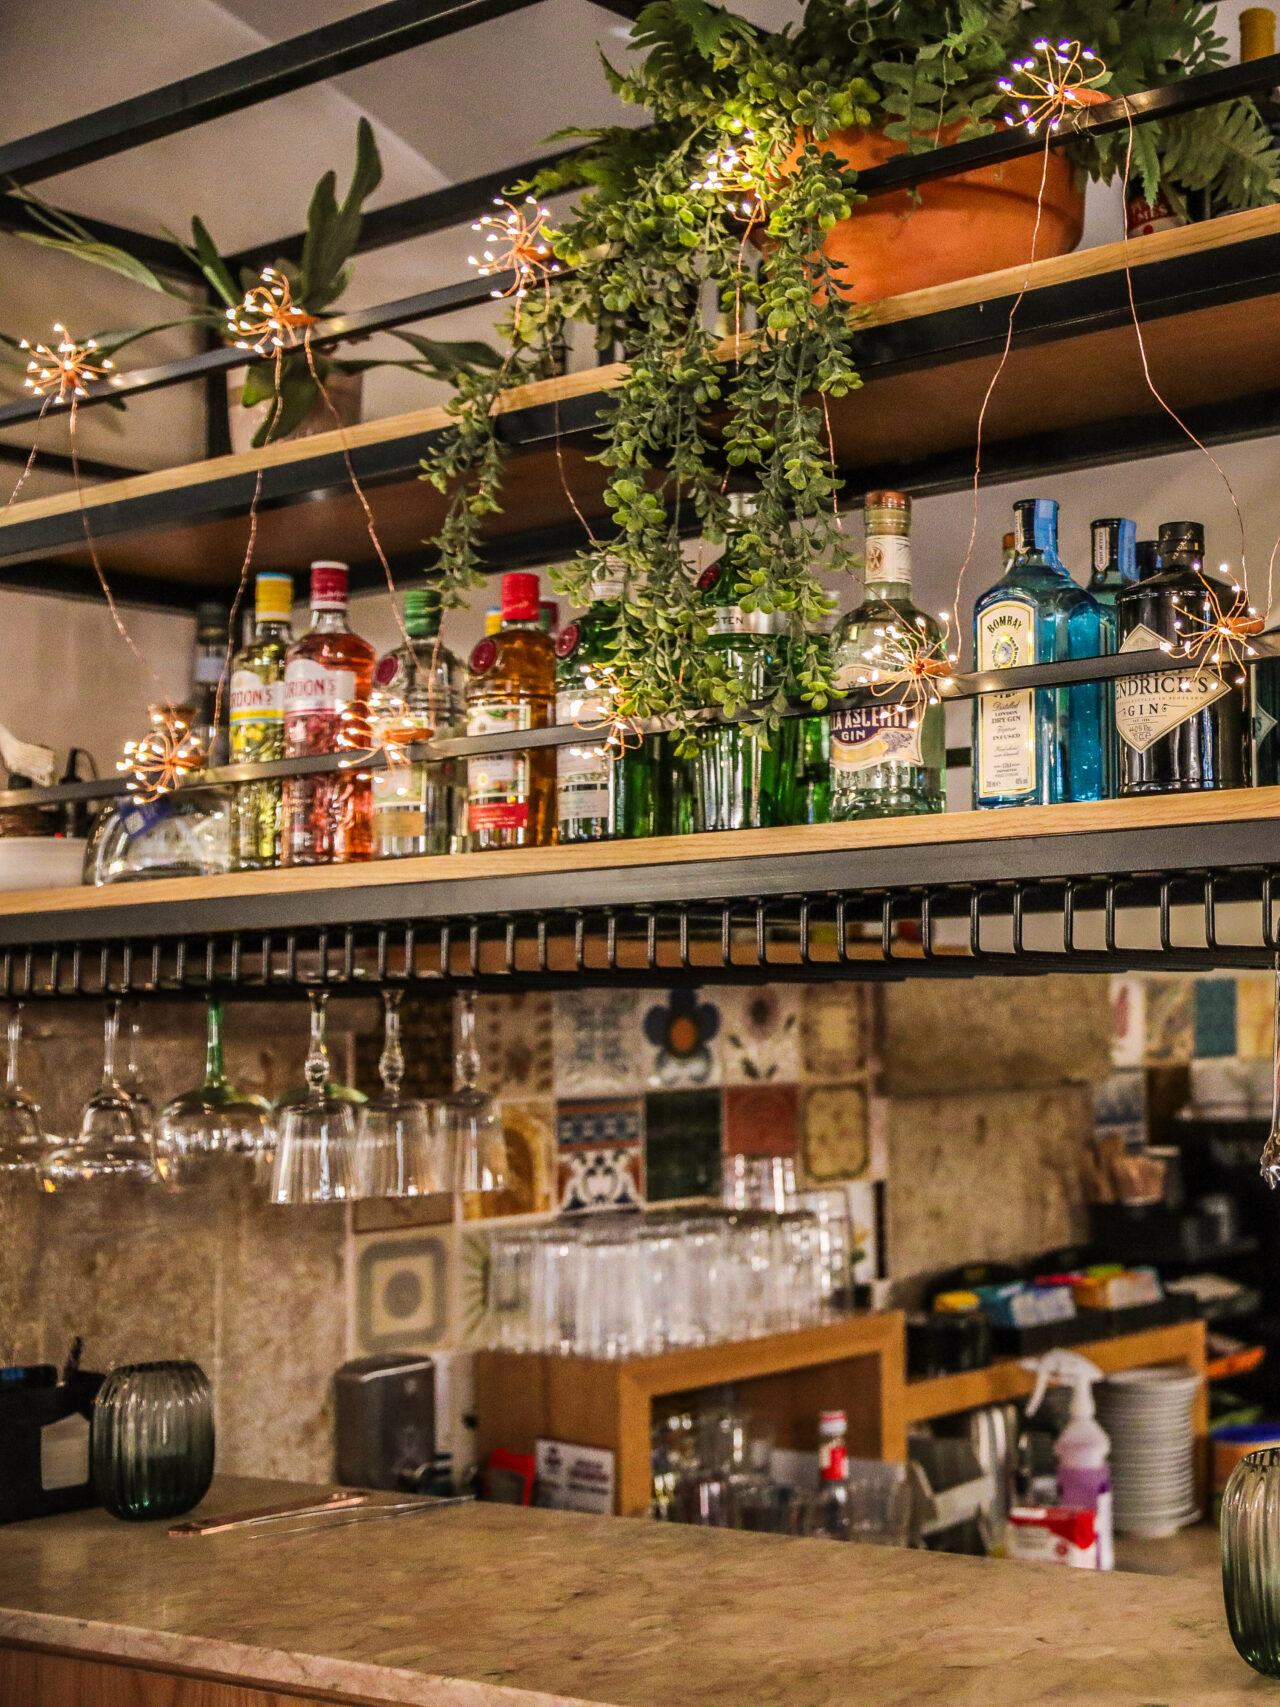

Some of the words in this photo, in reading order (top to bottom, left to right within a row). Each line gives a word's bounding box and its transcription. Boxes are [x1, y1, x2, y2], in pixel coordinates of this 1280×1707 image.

[720, 616, 744, 625] TEN
[986, 615, 1022, 634] BOMBAY
[1127, 702, 1159, 718] GIN
[841, 729, 866, 742] GIN
